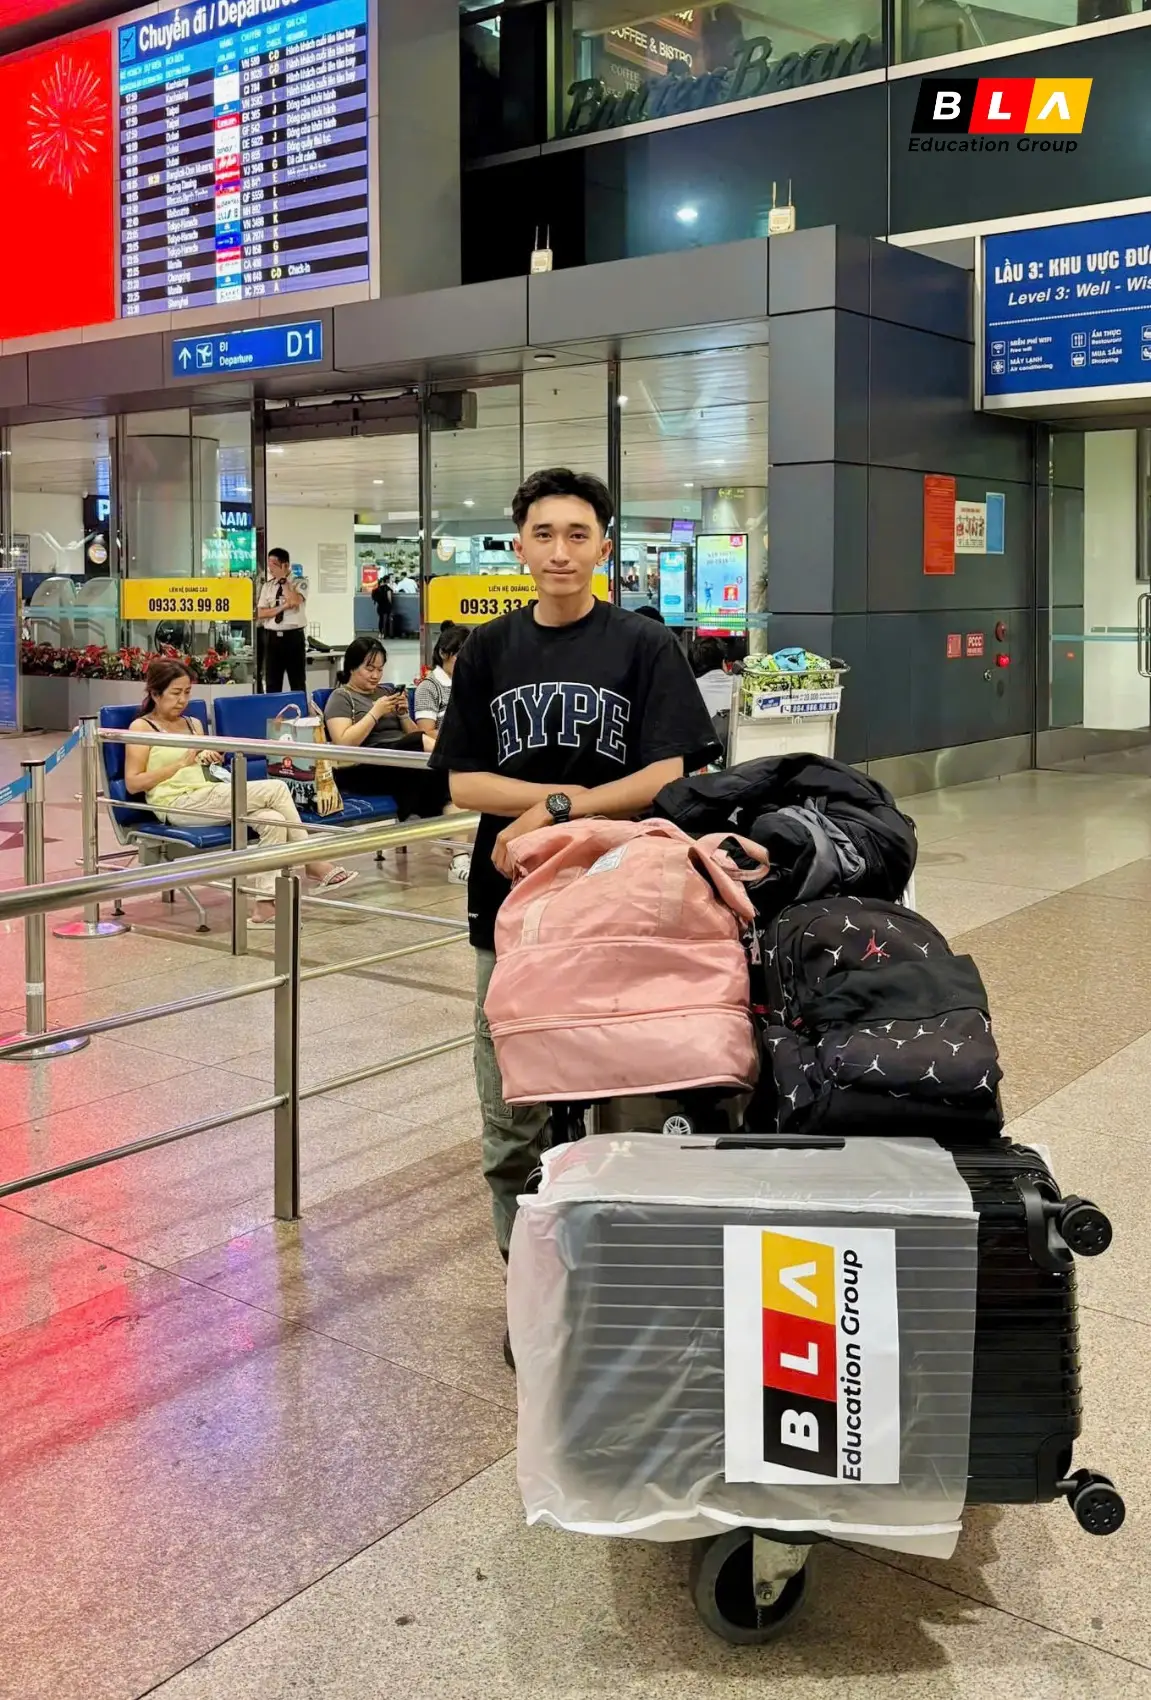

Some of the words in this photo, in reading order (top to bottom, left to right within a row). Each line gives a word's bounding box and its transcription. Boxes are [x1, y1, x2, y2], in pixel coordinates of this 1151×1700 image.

[138, 8, 190, 51] Chuyến
[193, 6, 206, 35] đi
[218, 0, 299, 28] Departu
[994, 258, 1024, 284] LẦU
[1028, 262, 1044, 279] 3:
[1049, 255, 1082, 278] KHU
[1086, 250, 1120, 274] VỰC
[1124, 245, 1151, 268] ĐƯ
[1008, 288, 1051, 306] Level
[1054, 286, 1070, 301] 3:
[1076, 280, 1110, 298] Well
[220, 354, 254, 367] Departure
[286, 329, 313, 358] D1
[149, 598, 230, 612] 0933.33.99.88
[490, 682, 631, 766] HYPE
[840, 1248, 863, 1336] Group
[778, 1260, 820, 1453] BLA
[840, 1342, 862, 1482] Education
